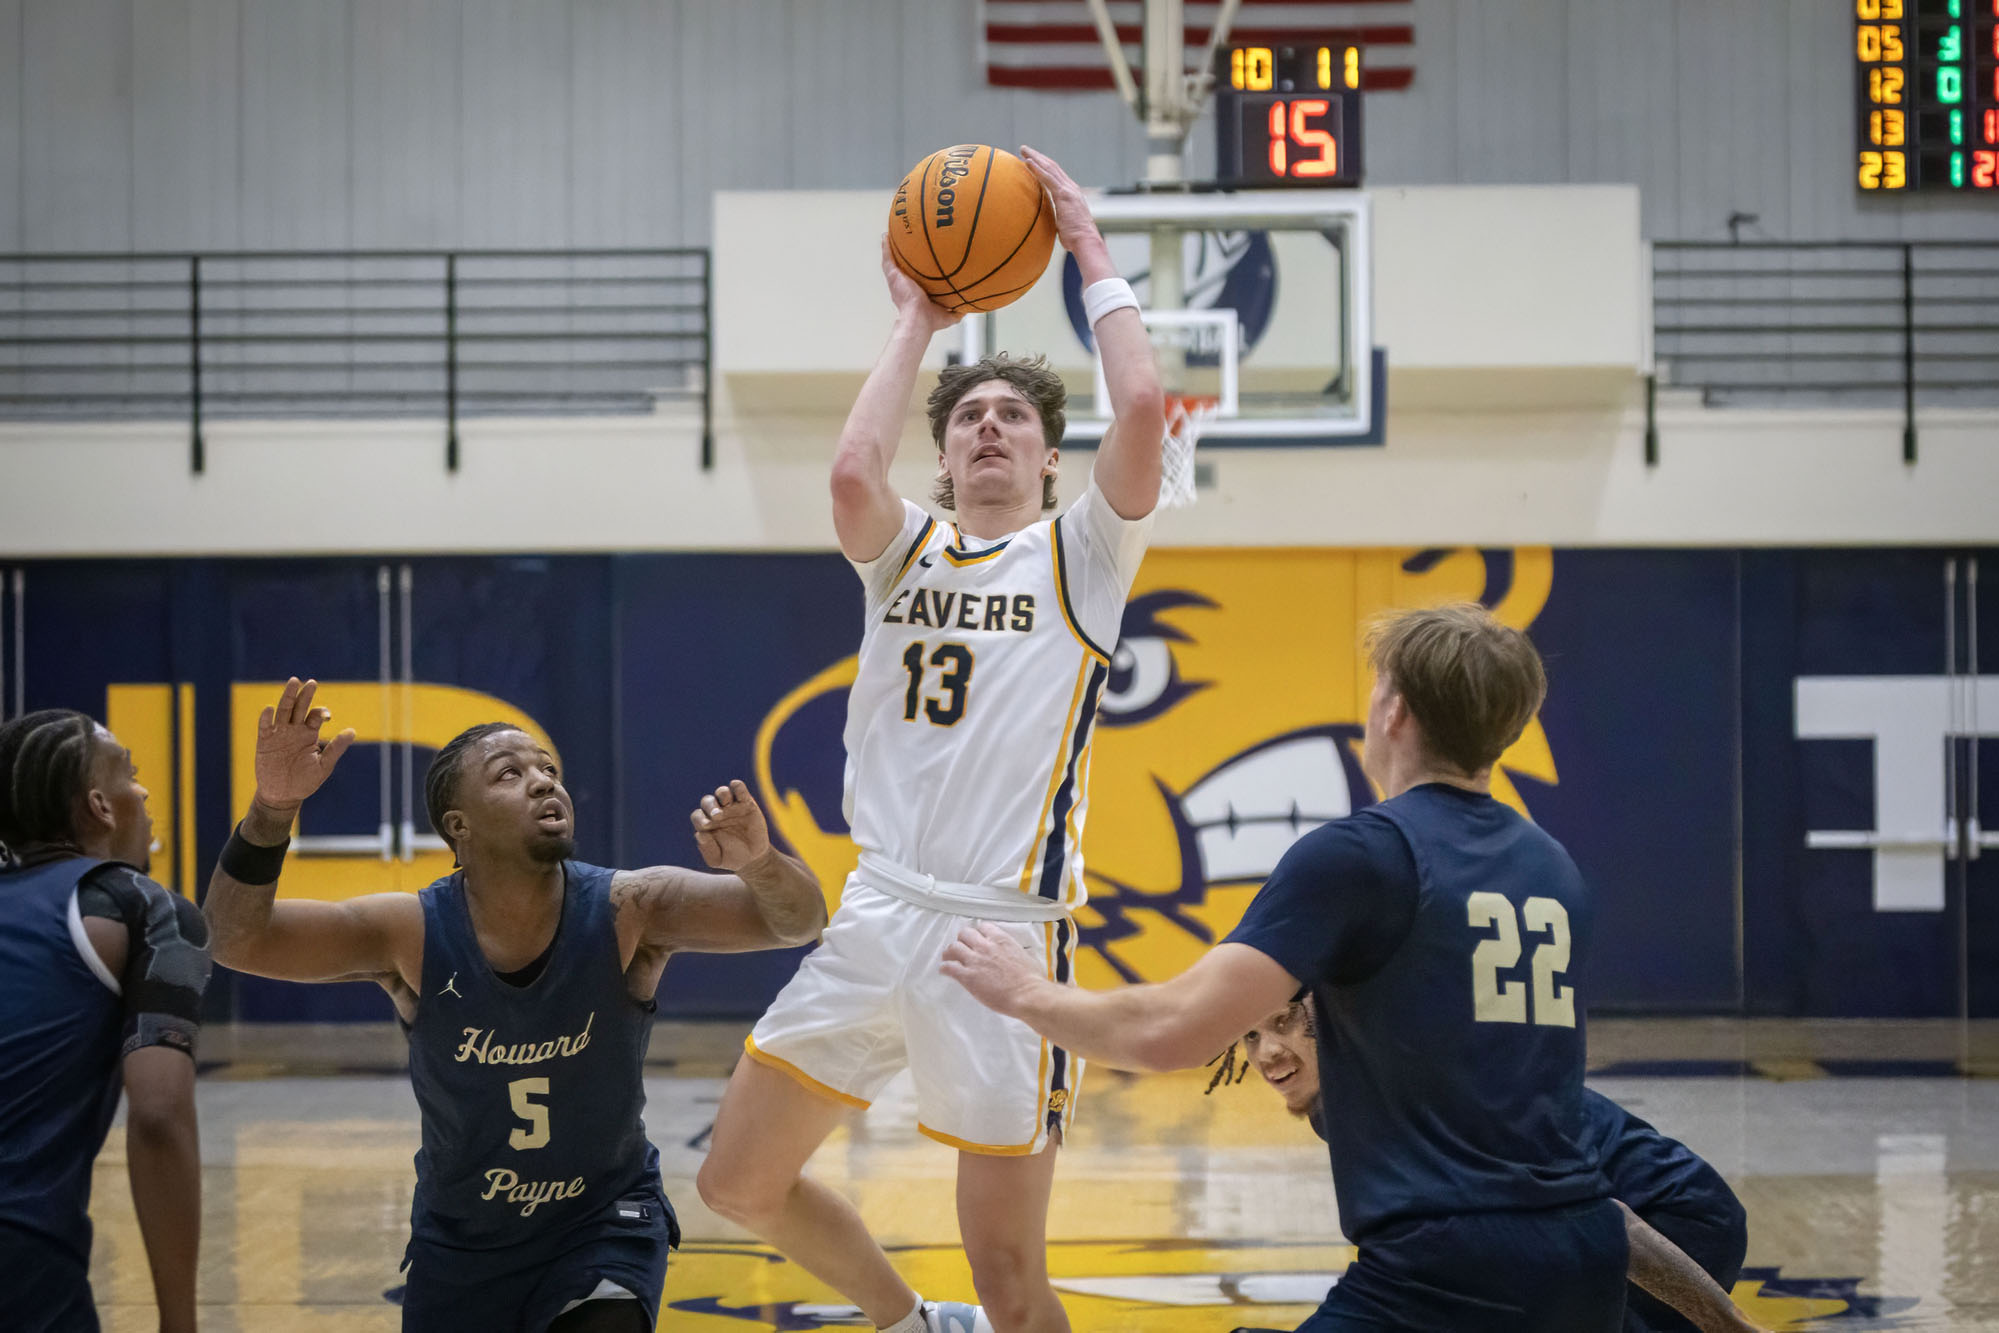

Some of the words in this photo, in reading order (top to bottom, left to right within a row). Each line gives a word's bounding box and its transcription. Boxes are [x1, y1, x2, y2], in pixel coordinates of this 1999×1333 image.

[1857, 25, 1904, 62] 05
[1869, 67, 1904, 104] 12
[1936, 66, 1962, 104] 0
[1268, 99, 1337, 178] 15
[1870, 109, 1904, 146] 13
[936, 145, 979, 229] Wilson
[1859, 151, 1906, 189] 23
[883, 587, 1036, 633] EAVERS
[902, 640, 975, 728] 13
[1467, 891, 1576, 1029] 22
[454, 1011, 595, 1065] Howard
[508, 1077, 550, 1151] 5
[480, 1168, 585, 1218] Payne
